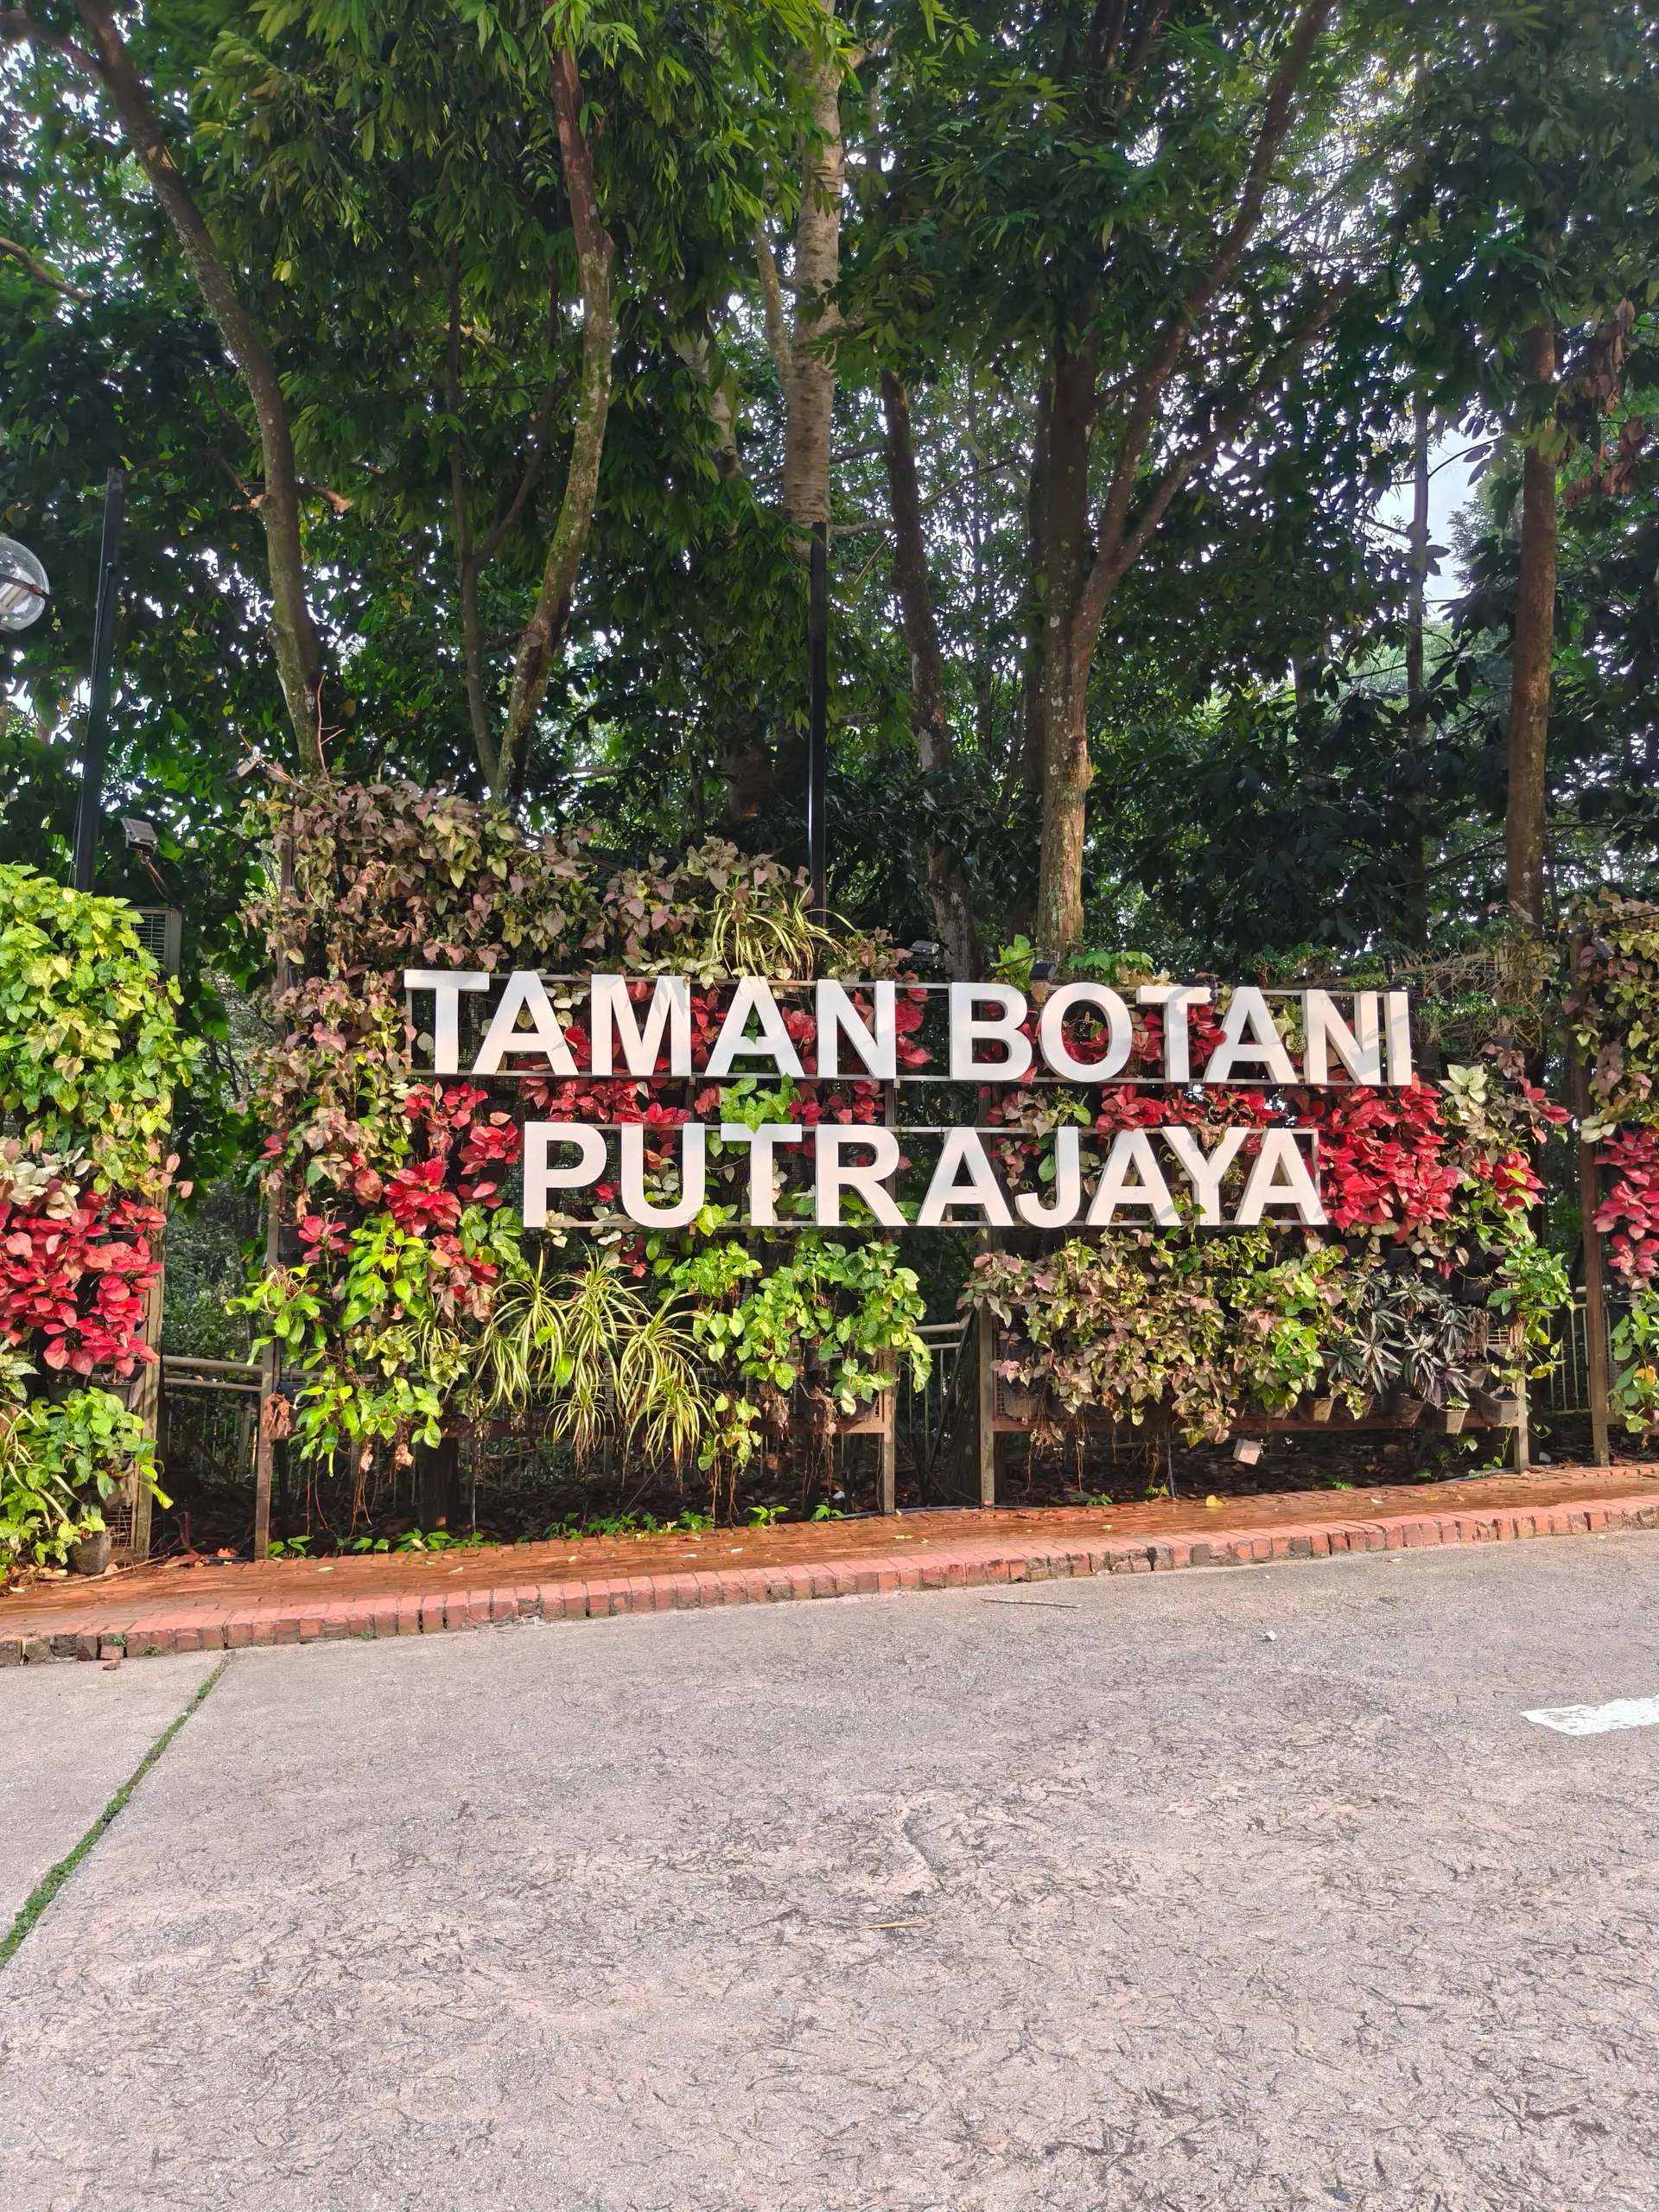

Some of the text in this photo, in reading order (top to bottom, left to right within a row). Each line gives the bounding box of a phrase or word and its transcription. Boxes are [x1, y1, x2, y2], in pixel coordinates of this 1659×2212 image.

[404, 969, 1413, 1086] TAMAN BOTANI
[523, 1121, 1328, 1229] PUTRAJAYA
